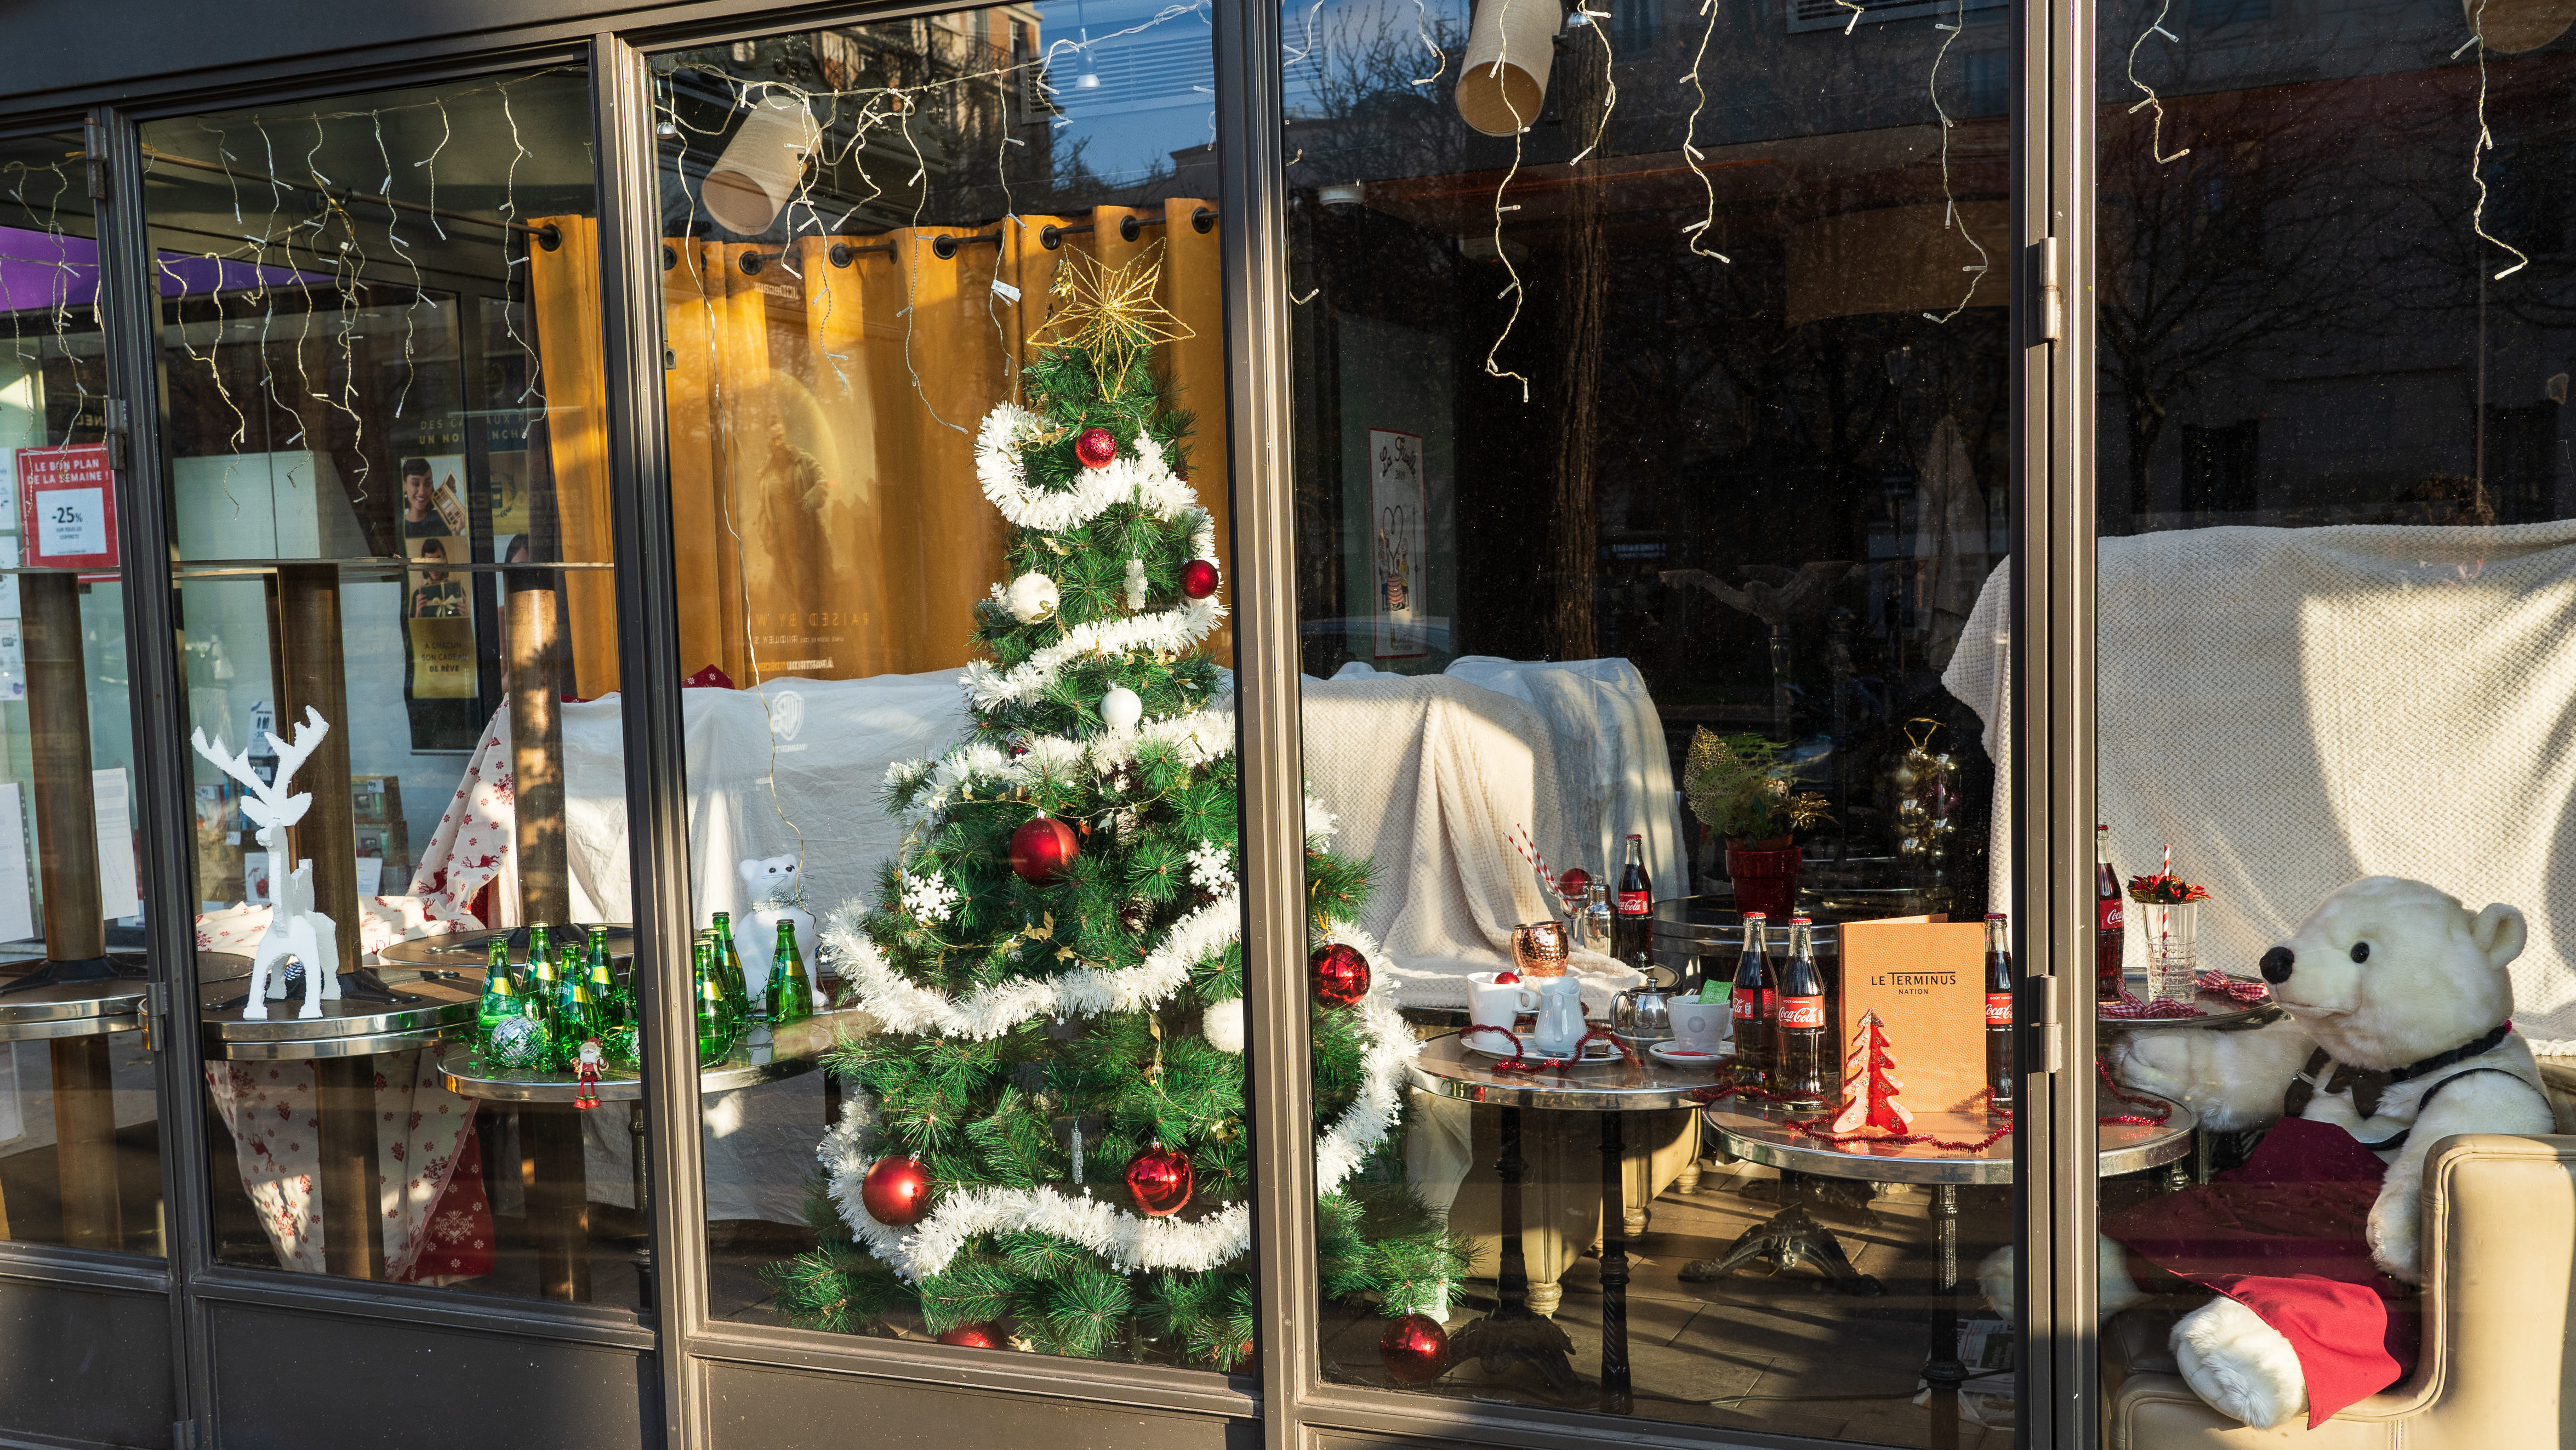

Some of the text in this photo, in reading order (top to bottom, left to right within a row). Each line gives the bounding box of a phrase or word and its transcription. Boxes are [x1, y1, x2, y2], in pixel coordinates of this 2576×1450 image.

[420, 419, 443, 430] DES
[419, 435, 435, 445] UN
[35, 459, 99, 473] LE BON PLAN
[27, 475, 40, 485] DE
[43, 474, 56, 484] LA
[59, 471, 102, 484] SEMAINE
[52, 507, 83, 524] -25%
[421, 652, 468, 661] SON CADEAU
[441, 663, 459, 673] RÊVE
[1871, 971, 1956, 986] LE TERMINUS
[1779, 1007, 1818, 1023] Coca-Cola
